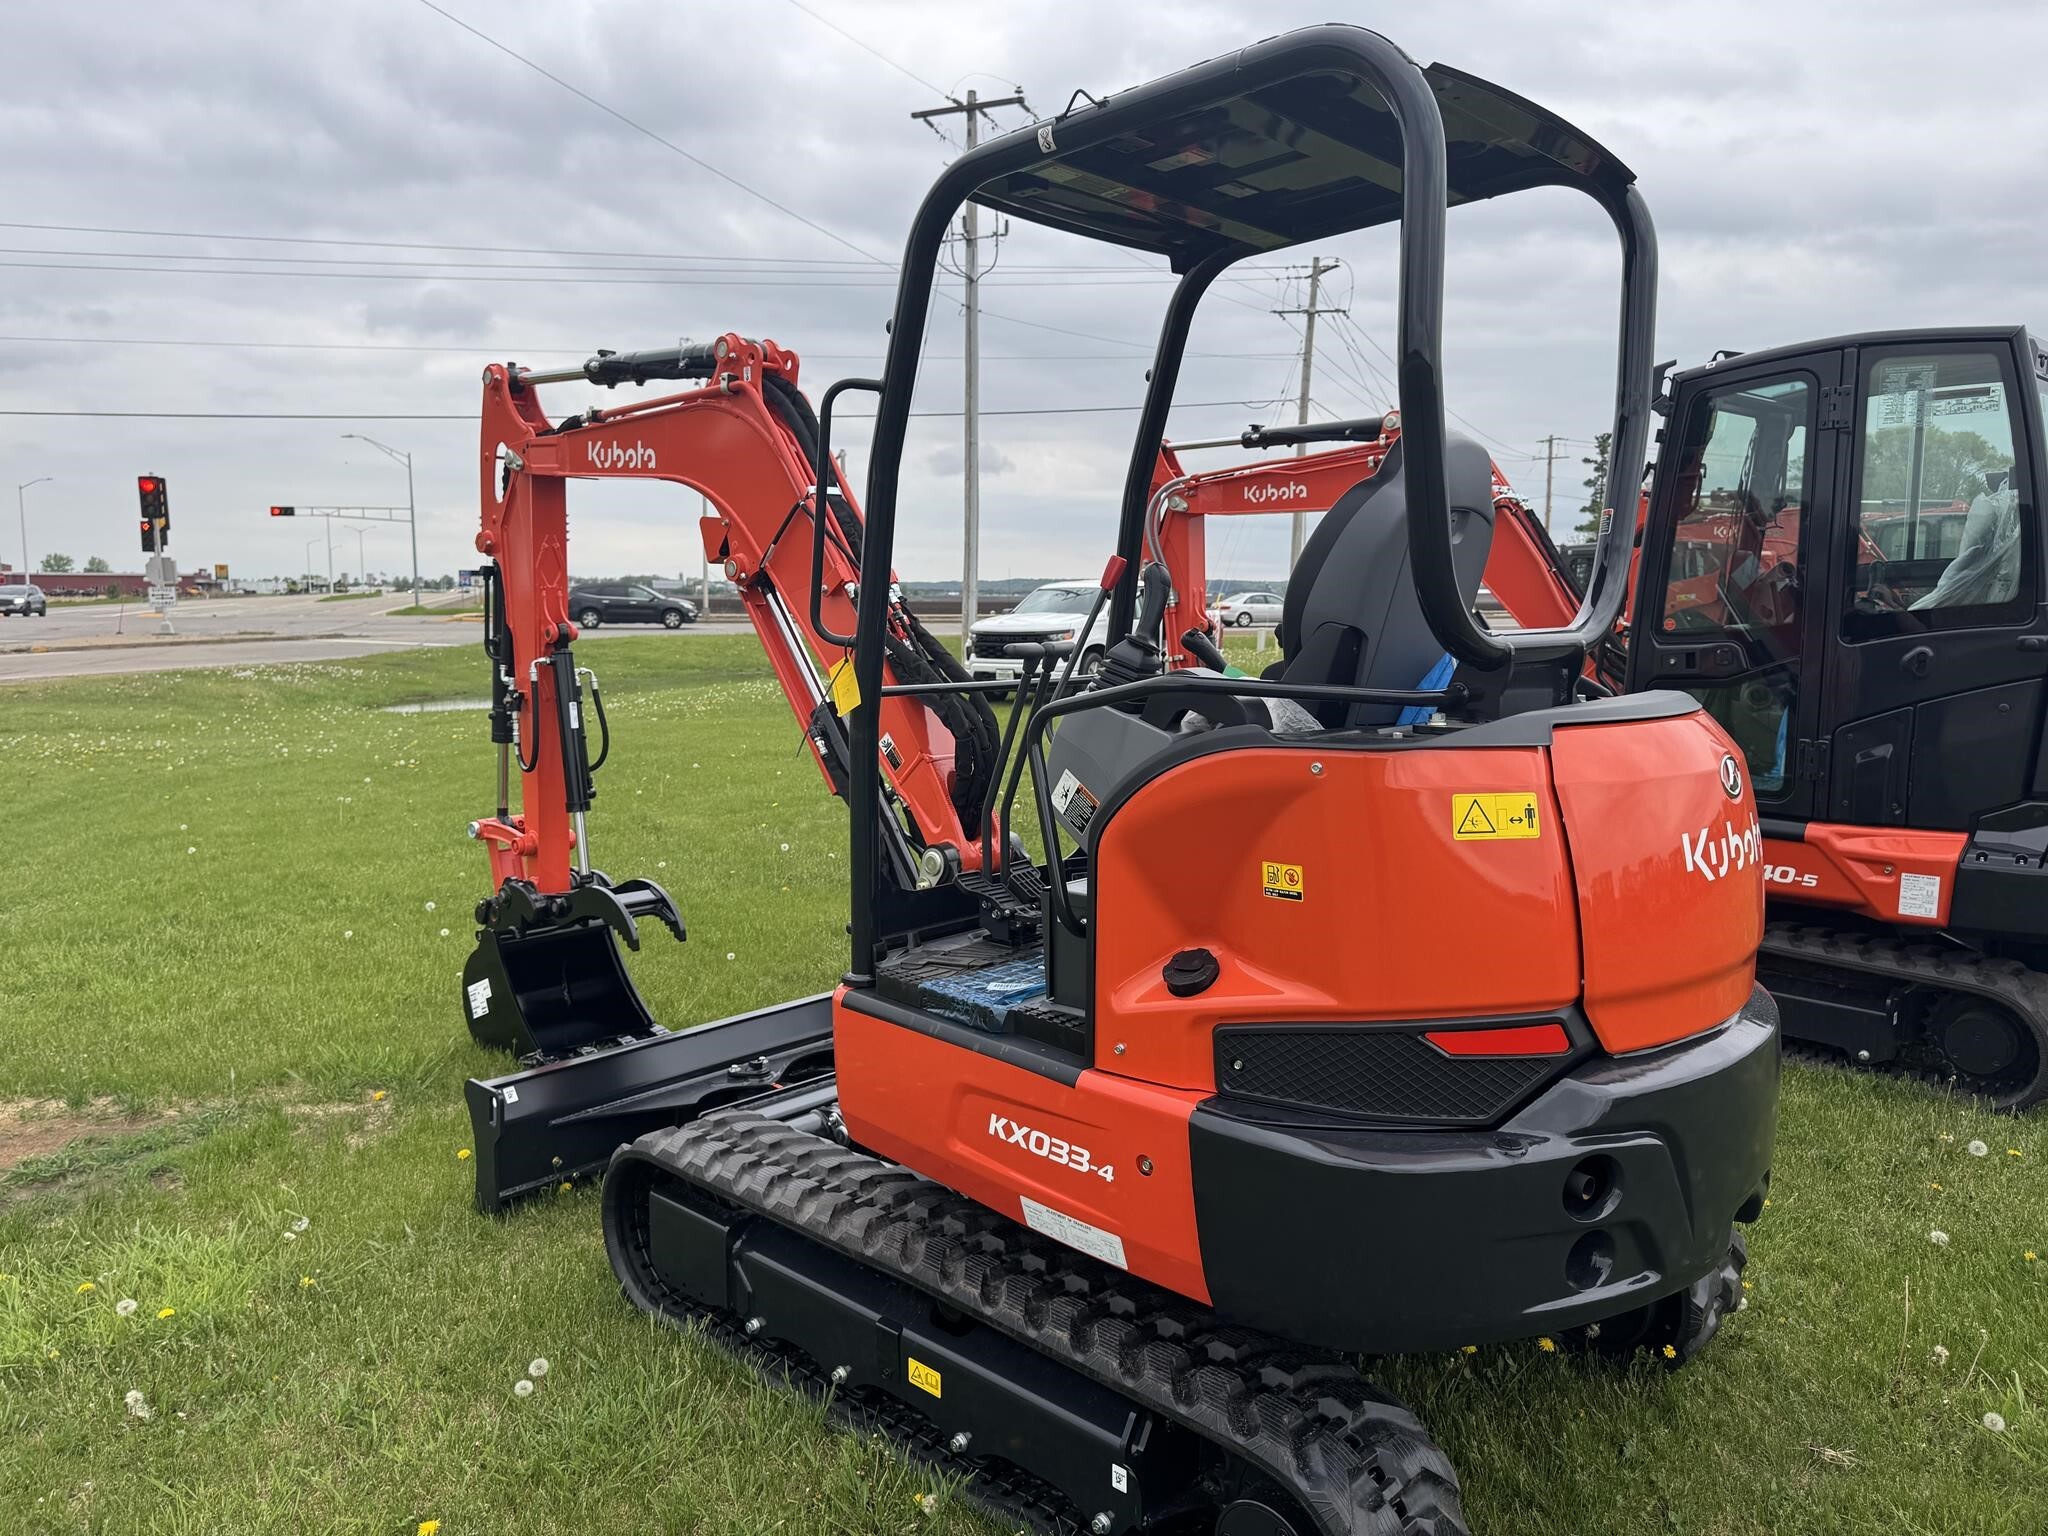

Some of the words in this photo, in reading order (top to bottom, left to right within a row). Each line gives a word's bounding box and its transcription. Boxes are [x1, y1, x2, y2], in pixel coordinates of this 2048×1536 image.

[587, 440, 656, 469] Kubota
[1243, 481, 1308, 503] Kubota
[988, 1113, 1115, 1183] KX033-4
